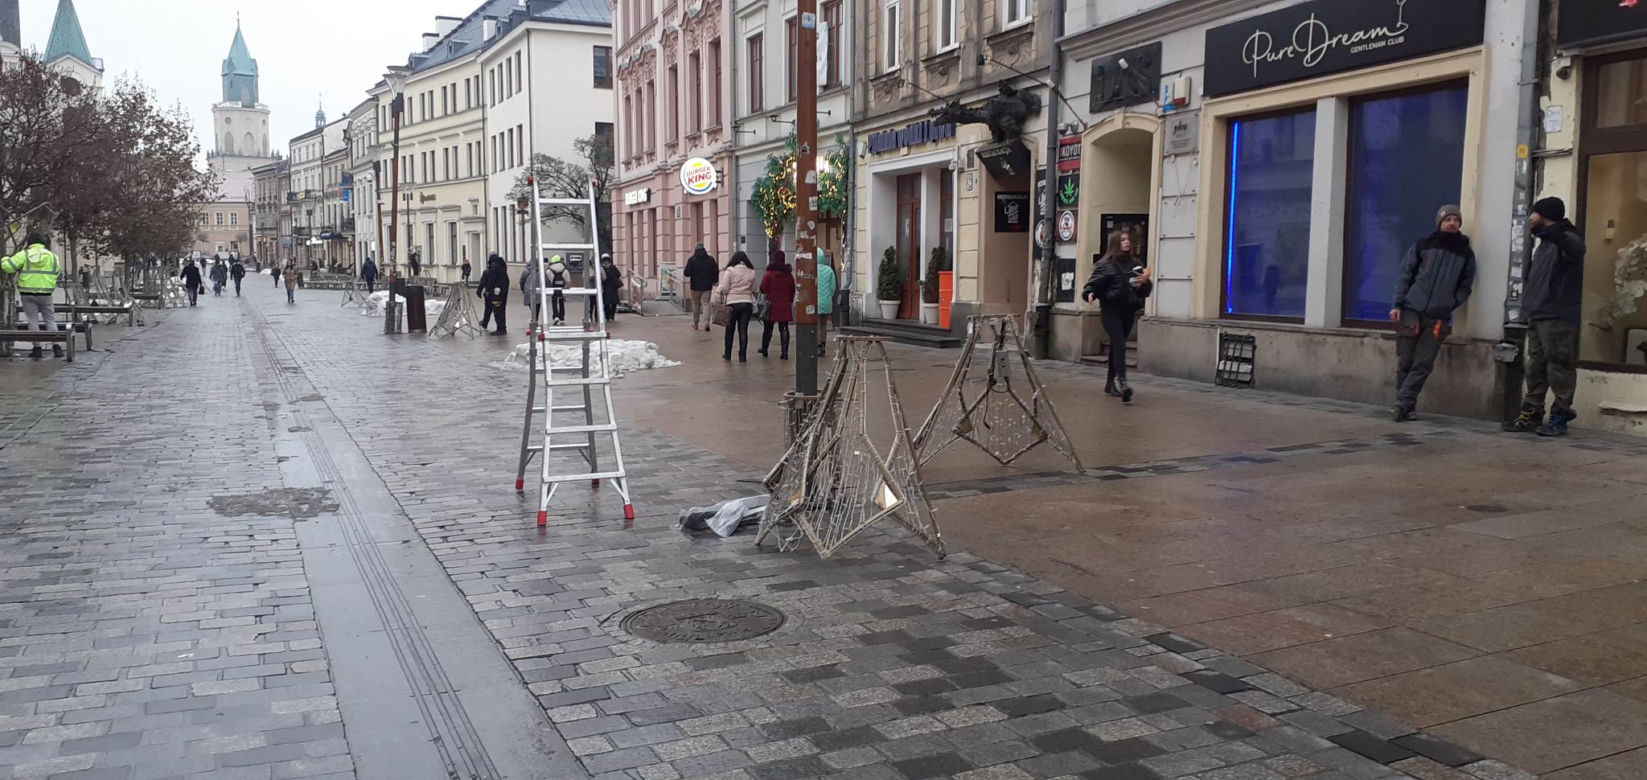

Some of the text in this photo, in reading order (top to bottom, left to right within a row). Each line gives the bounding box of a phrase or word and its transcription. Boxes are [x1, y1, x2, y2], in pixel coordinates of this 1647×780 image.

[1243, 13, 1408, 78] Pure Dream
[1350, 36, 1405, 54] GENTLEMAN CLUB
[686, 166, 711, 178] BURGER
[687, 172, 711, 185] KING
